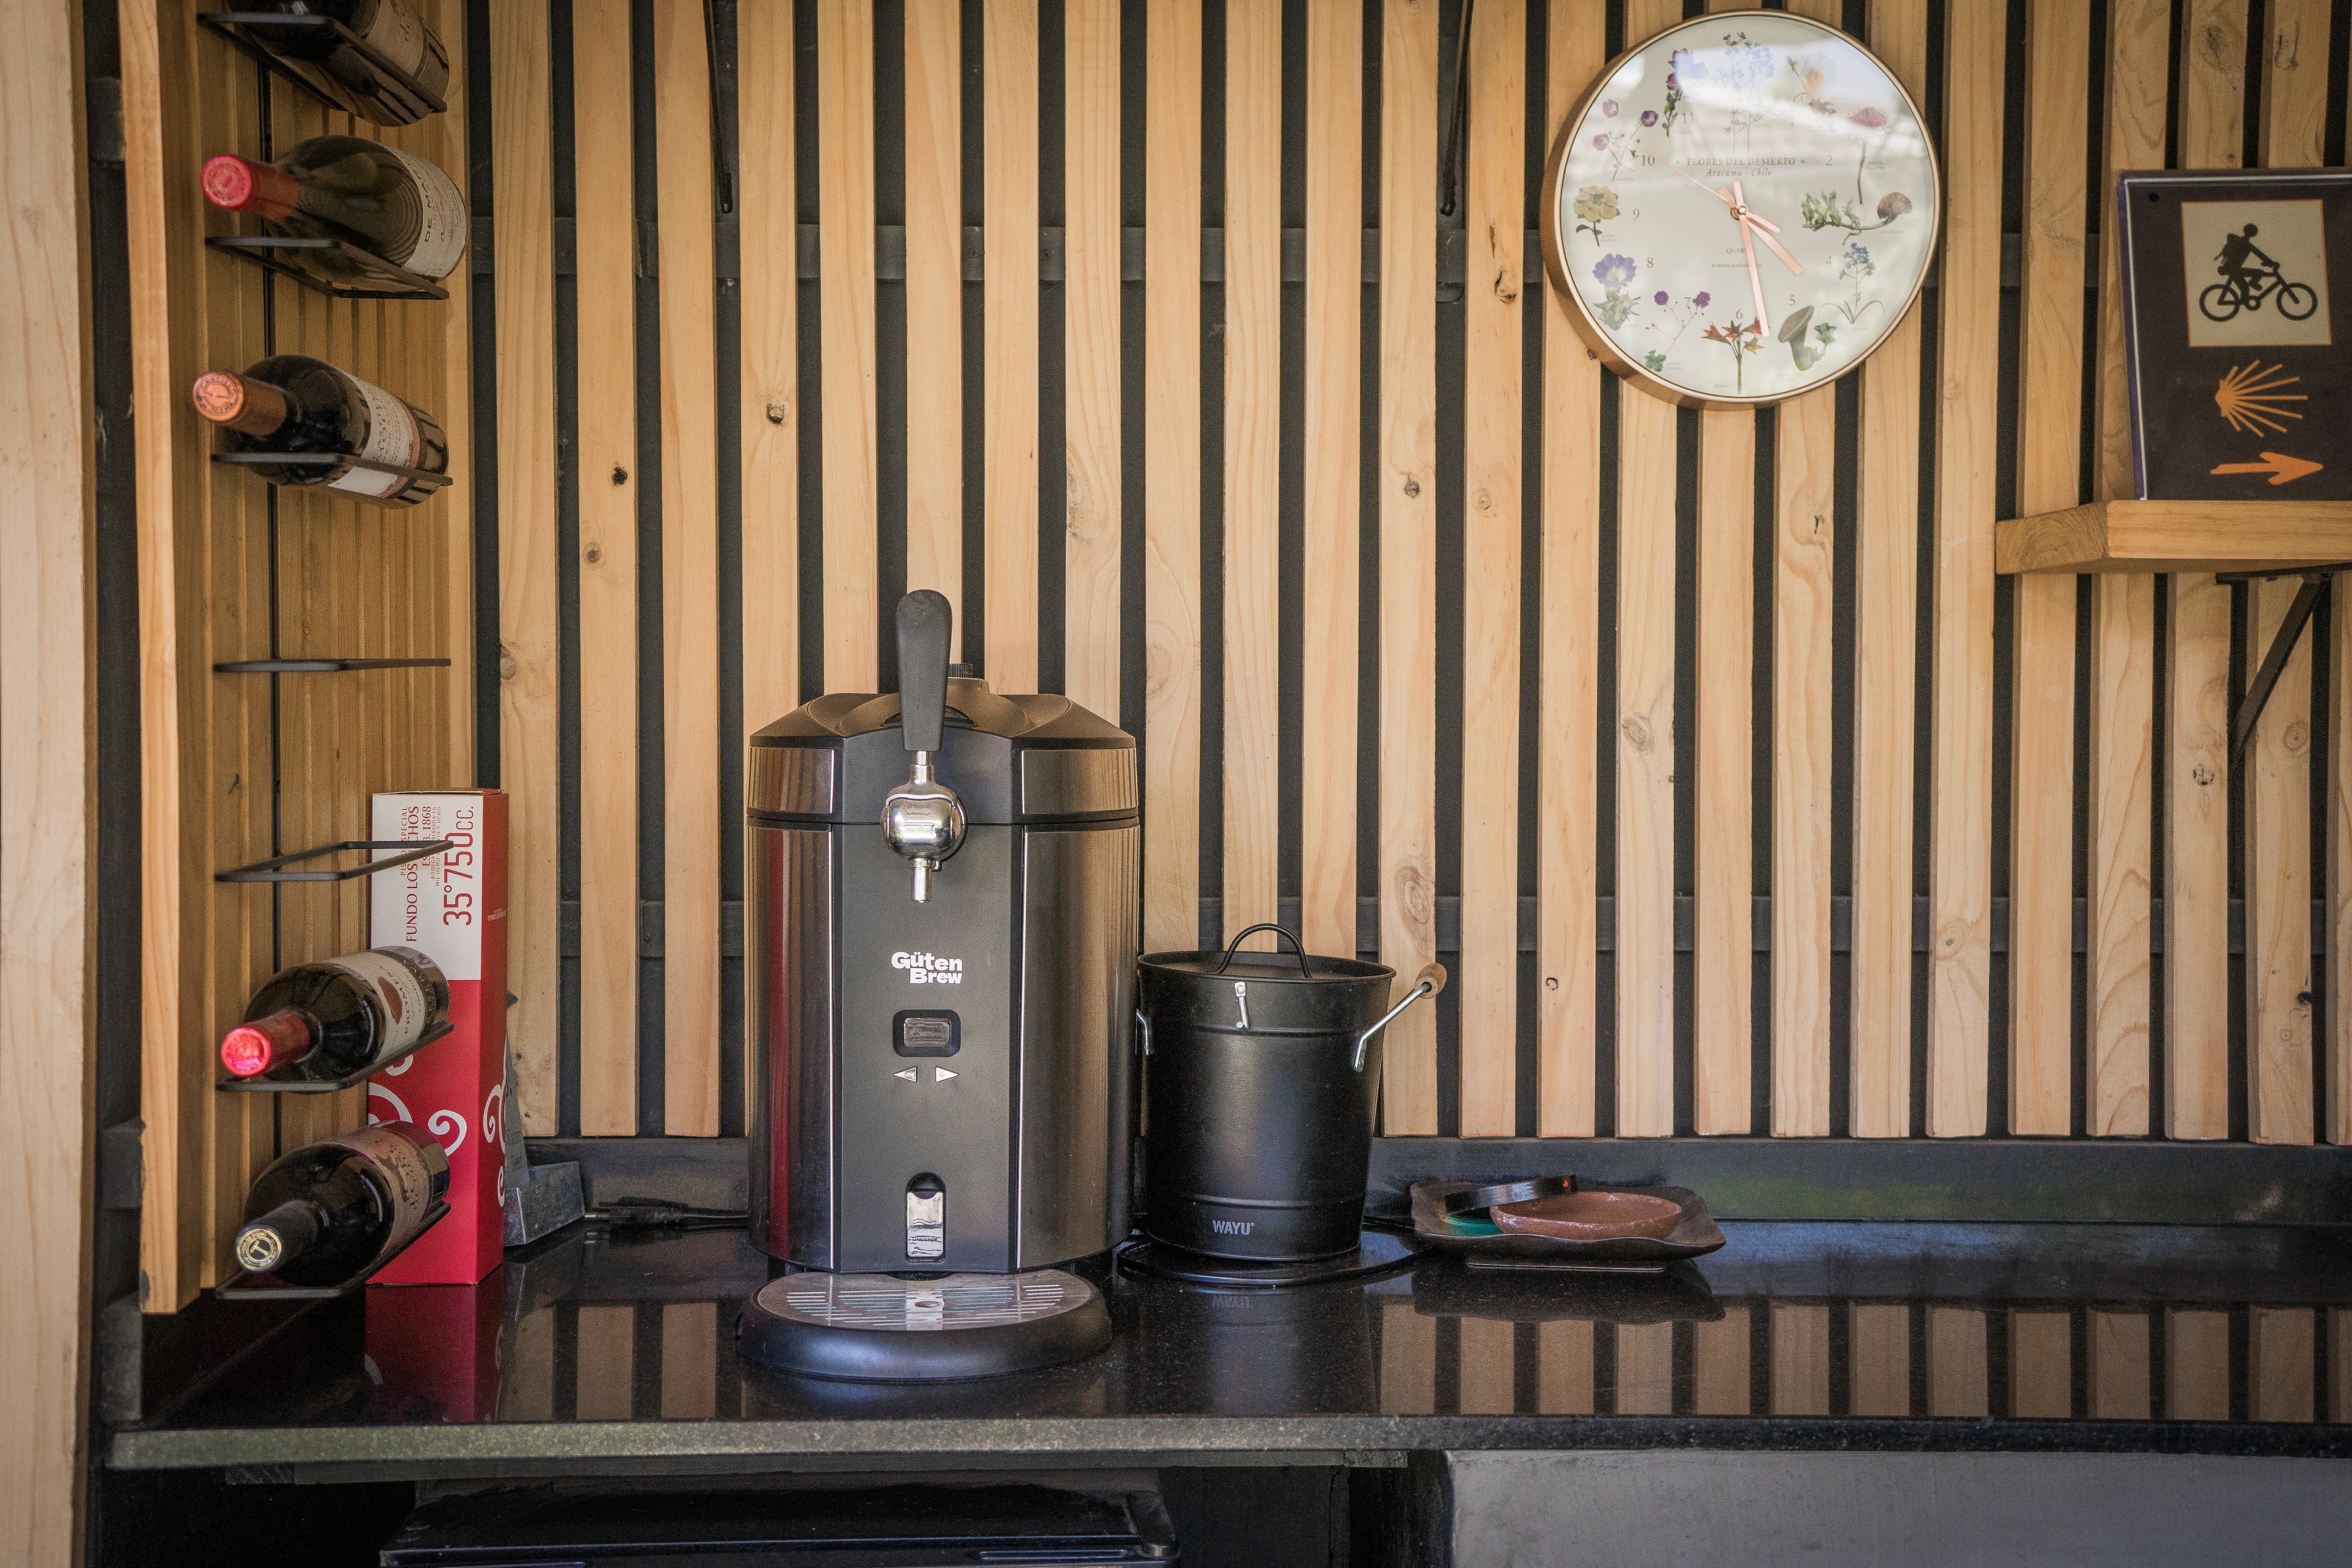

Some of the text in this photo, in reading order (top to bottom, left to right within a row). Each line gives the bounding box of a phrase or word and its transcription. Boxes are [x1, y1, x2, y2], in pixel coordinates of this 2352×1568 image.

[1682, 112, 1694, 123] 11
[1642, 154, 1655, 165] 10
[1687, 158, 1722, 166] FLORES
[1748, 157, 1795, 166] DESIERTO
[1825, 155, 1833, 166] 2
[1705, 168, 1743, 177] Atacama
[1751, 167, 1773, 176] Chile
[1632, 208, 1640, 220] 9
[1647, 257, 1654, 269] 8
[1825, 256, 1832, 267] 4
[1684, 297, 1691, 308] 7
[1788, 295, 1796, 307] 5
[1735, 308, 1743, 319] 6
[422, 806, 432, 830] 1868
[407, 864, 418, 889] LOS
[406, 893, 418, 942] FUNDO
[891, 951, 963, 971] Güten
[909, 967, 963, 984] Brew
[250, 1240, 270, 1256] T
